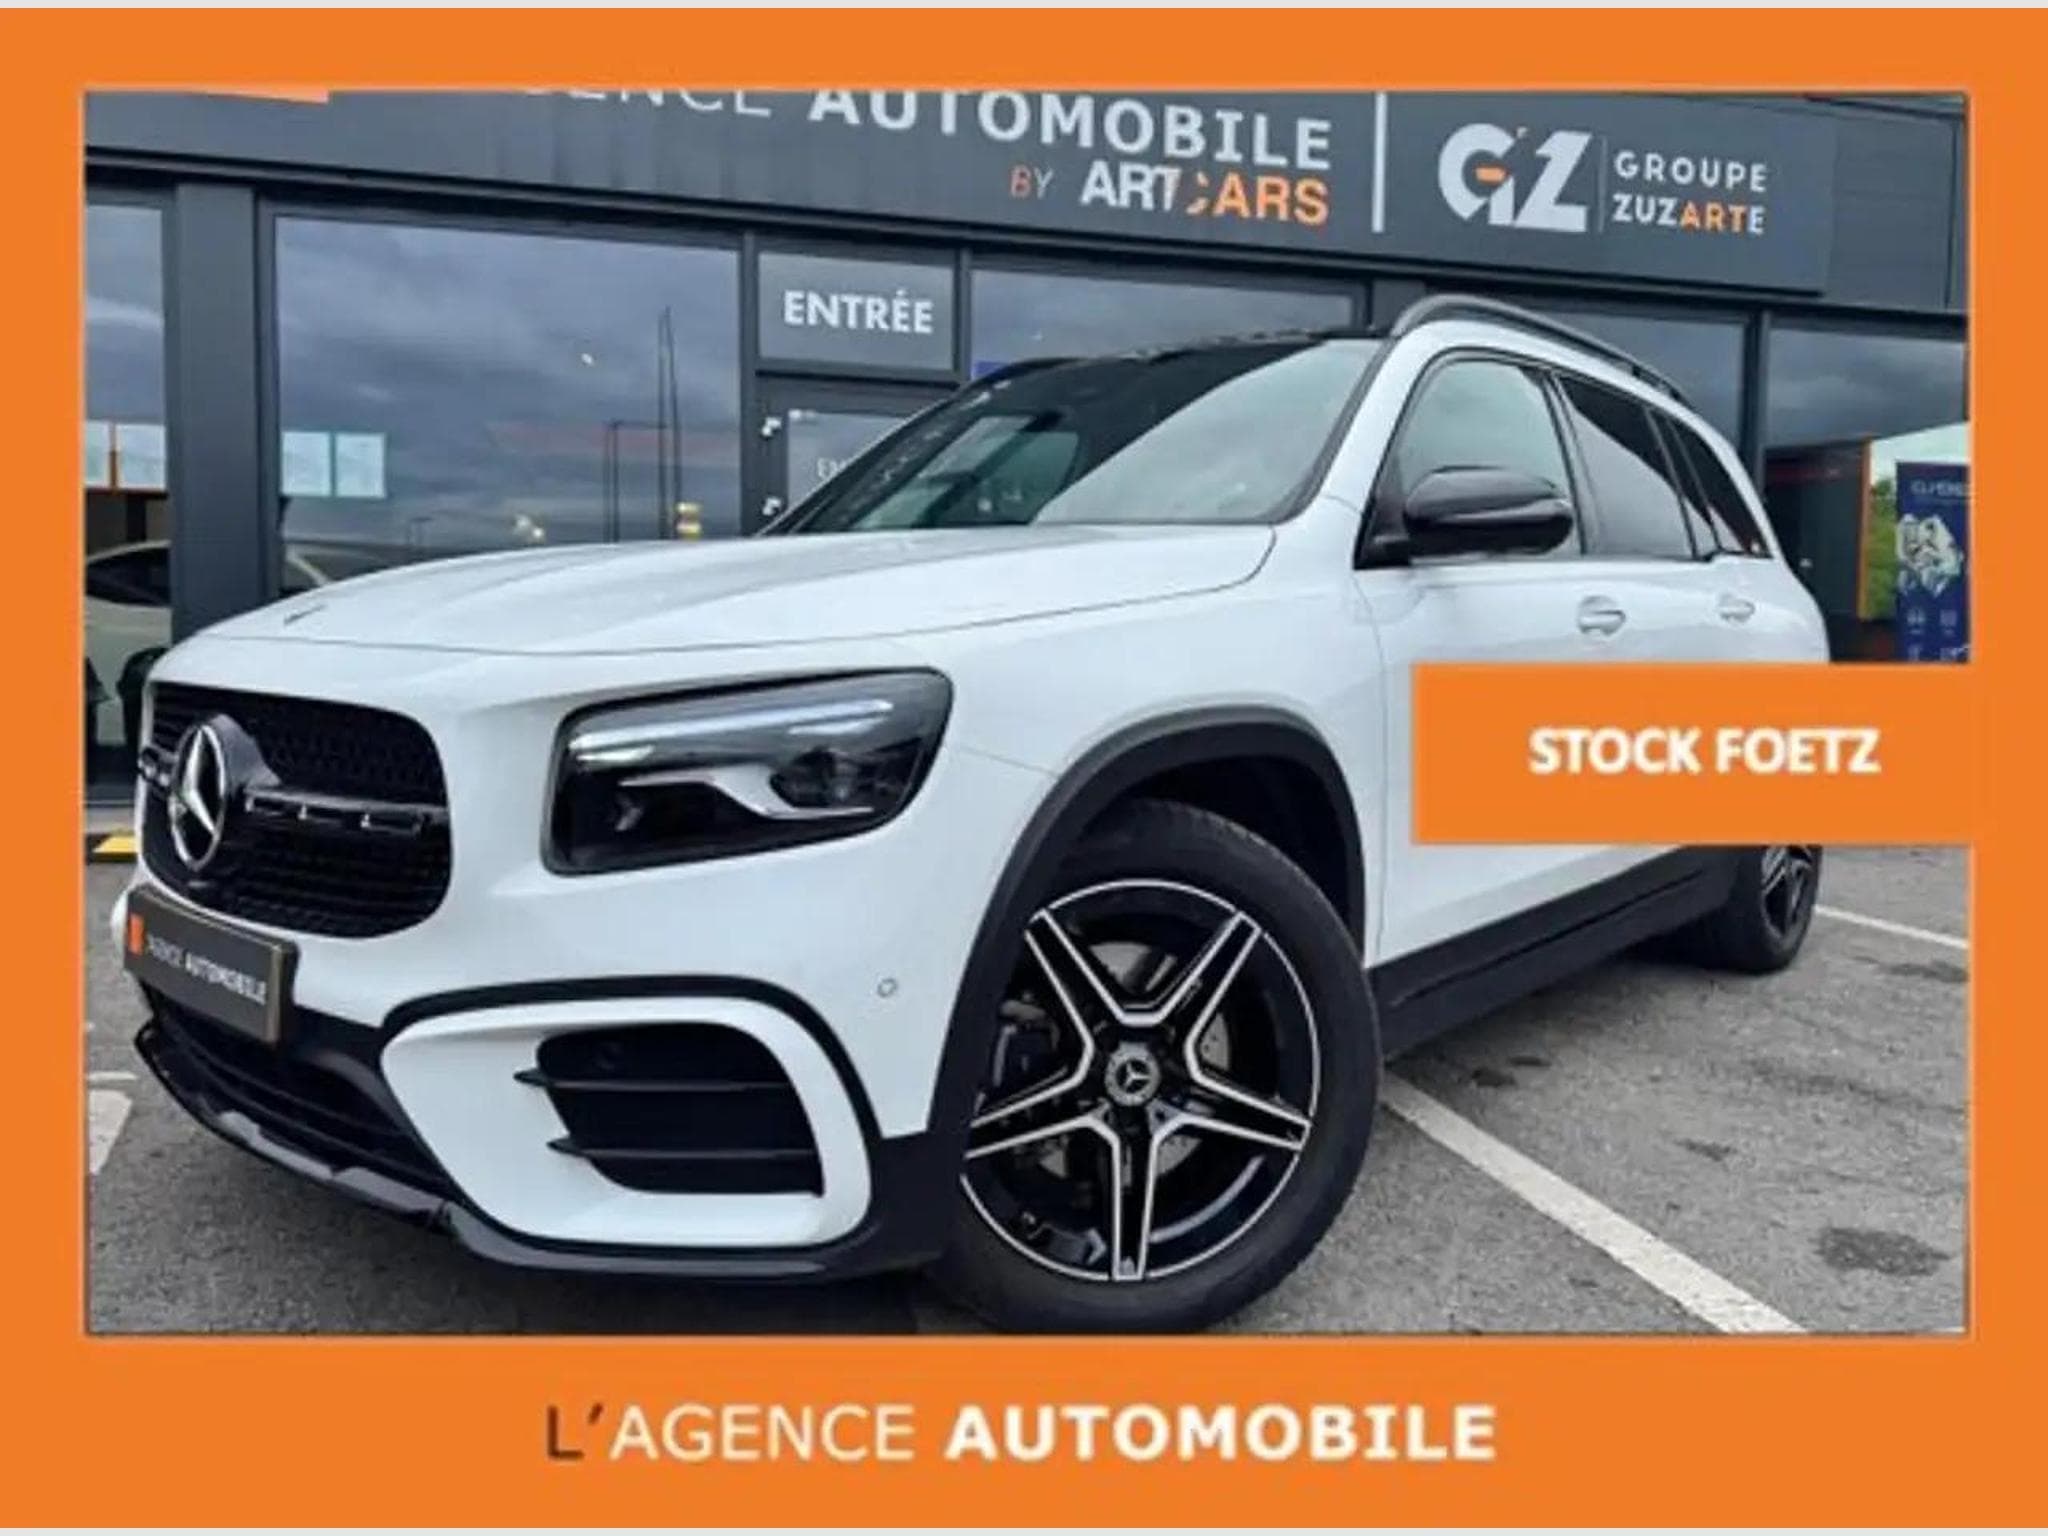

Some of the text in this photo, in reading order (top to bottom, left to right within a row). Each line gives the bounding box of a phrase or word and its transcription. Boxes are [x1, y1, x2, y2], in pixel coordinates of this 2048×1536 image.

[807, 91, 1332, 170] AUTOMOBILE
[1010, 165, 1053, 199] BY
[1614, 150, 1768, 192] GROUPE
[1612, 193, 1766, 235] ZUZARTE
[783, 289, 934, 334] ENTRÉE
[184, 950, 267, 1006] AUTOMOBILE
